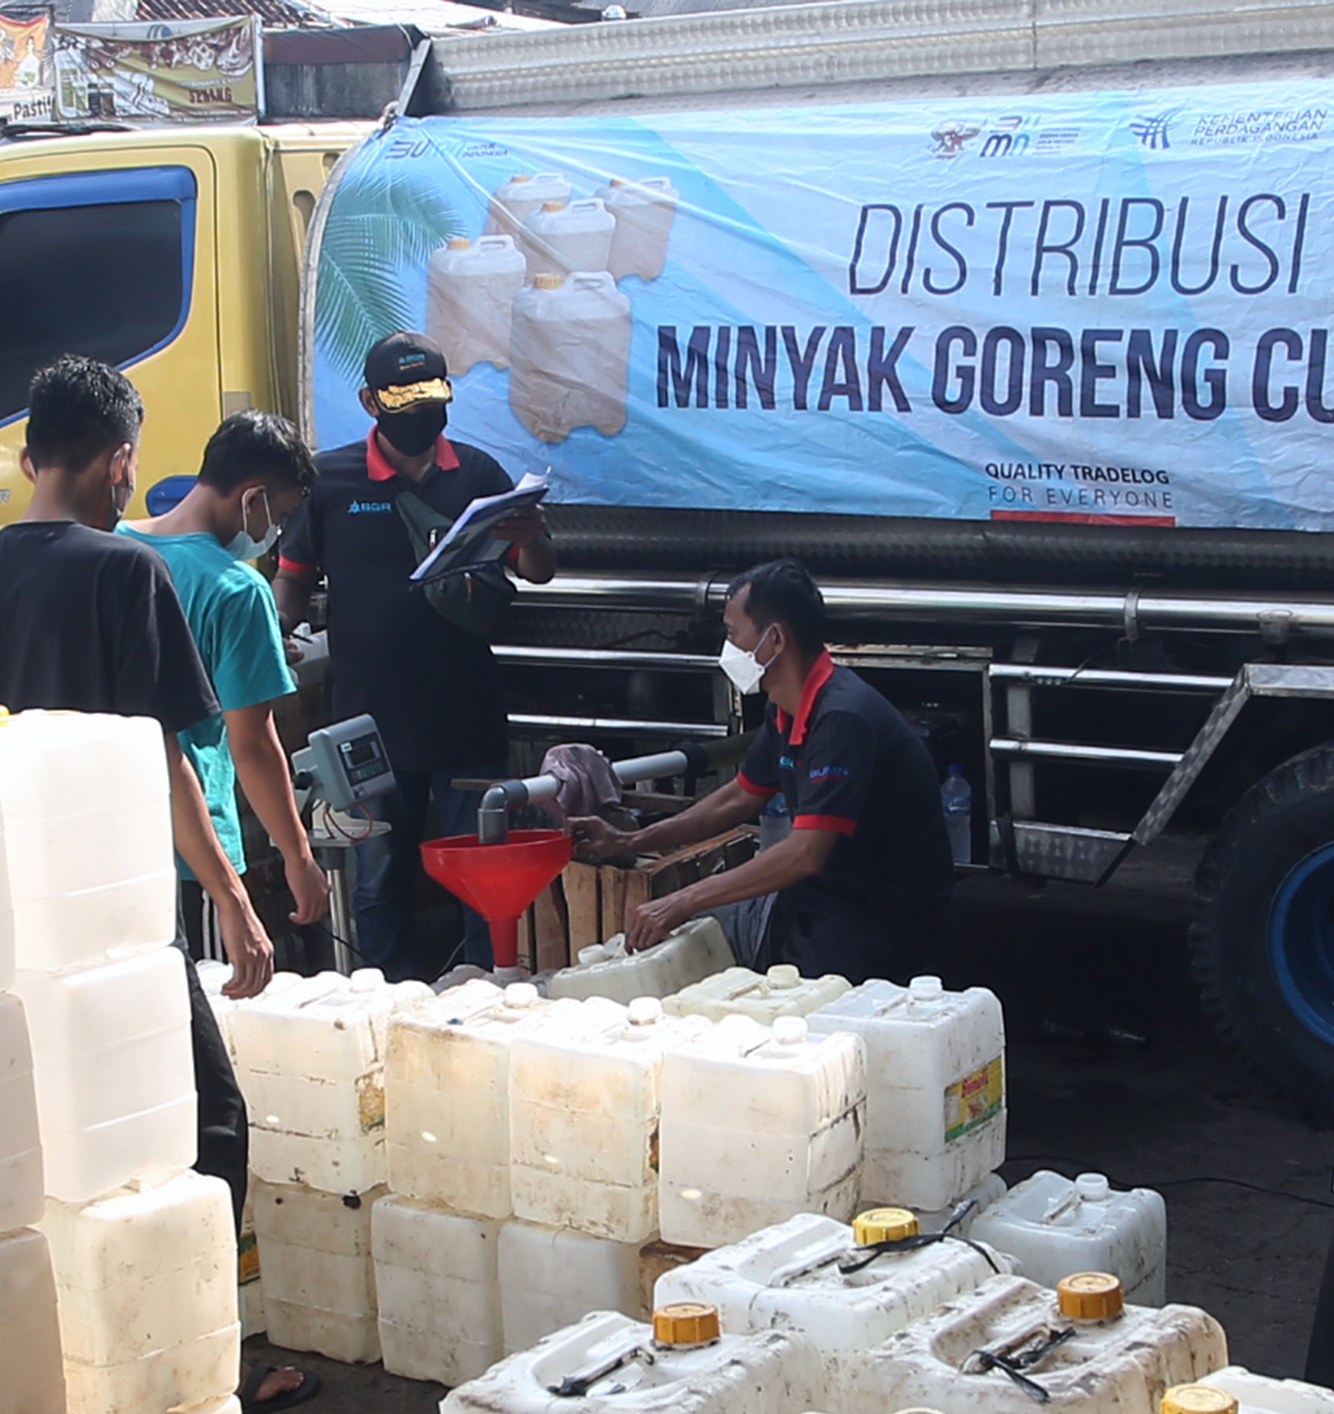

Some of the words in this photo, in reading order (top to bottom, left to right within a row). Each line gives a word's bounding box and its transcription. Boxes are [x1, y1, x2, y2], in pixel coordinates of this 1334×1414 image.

[1193, 120, 1324, 137] PERDAGANGAN
[1197, 108, 1328, 126] KEMENTERIAN
[1190, 135, 1248, 147] REPUBLIK
[848, 193, 1310, 297] DISTRIBUSI
[655, 324, 914, 415] MINYAK
[930, 327, 1231, 420] GORENG
[985, 462, 1067, 481] QUALITY
[1070, 464, 1171, 485] TRADELOG
[987, 485, 1033, 503] FOR
[1046, 488, 1174, 509] EVERYONE
